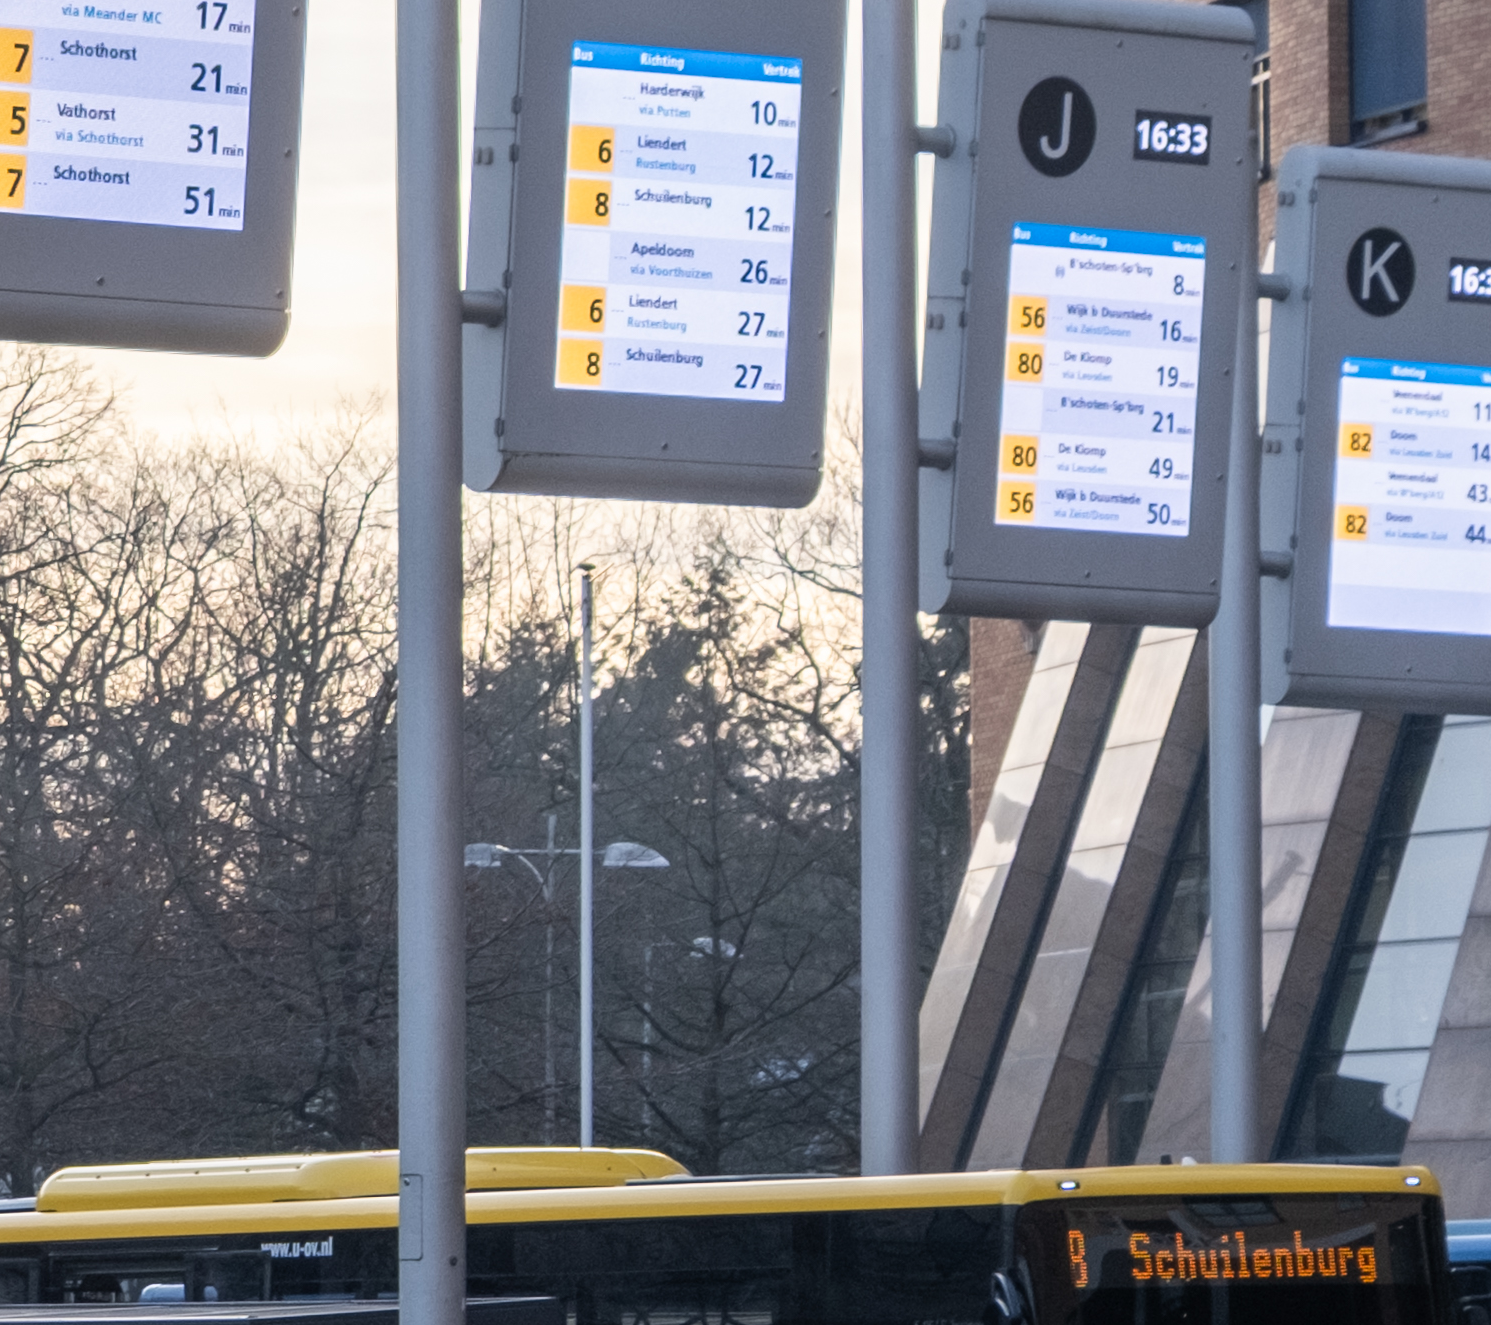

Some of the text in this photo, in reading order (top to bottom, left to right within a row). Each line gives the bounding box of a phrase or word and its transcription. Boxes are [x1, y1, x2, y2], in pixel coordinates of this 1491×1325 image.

[196, 1, 227, 31] 17
[13, 41, 137, 73] 7 Schothorst
[190, 63, 222, 93] 21
[11, 103, 116, 135] 5 Vathorst
[751, 101, 777, 125] 10
[1040, 92, 1073, 159] J
[1137, 119, 1208, 155] 16:33
[187, 124, 218, 154] 31
[599, 139, 612, 163] 6
[748, 153, 774, 178] 12
[7, 165, 130, 197] 7 Schothorst
[184, 186, 215, 216] 51
[595, 192, 609, 216] 8
[745, 206, 770, 231] 12
[740, 259, 768, 284] 26
[1361, 239, 1402, 302] K
[1173, 274, 1184, 296] 8
[590, 299, 603, 323] 6
[1021, 307, 1045, 328] 56
[738, 312, 765, 336] 27
[1160, 319, 1182, 342] 16
[586, 352, 600, 376] 8
[1018, 353, 1043, 375] 80
[734, 364, 762, 389] 27
[1157, 366, 1179, 387] 19
[1152, 411, 1174, 433] 21
[1474, 402, 1491, 422] 11
[1350, 433, 1371, 452] 82
[1472, 443, 1491, 462] 14
[1012, 446, 1037, 467] 80
[1149, 458, 1173, 479] 49
[1010, 492, 1034, 513] 56
[1147, 503, 1170, 525] 50
[1129, 1230, 1377, 1283] Schuilenburg
